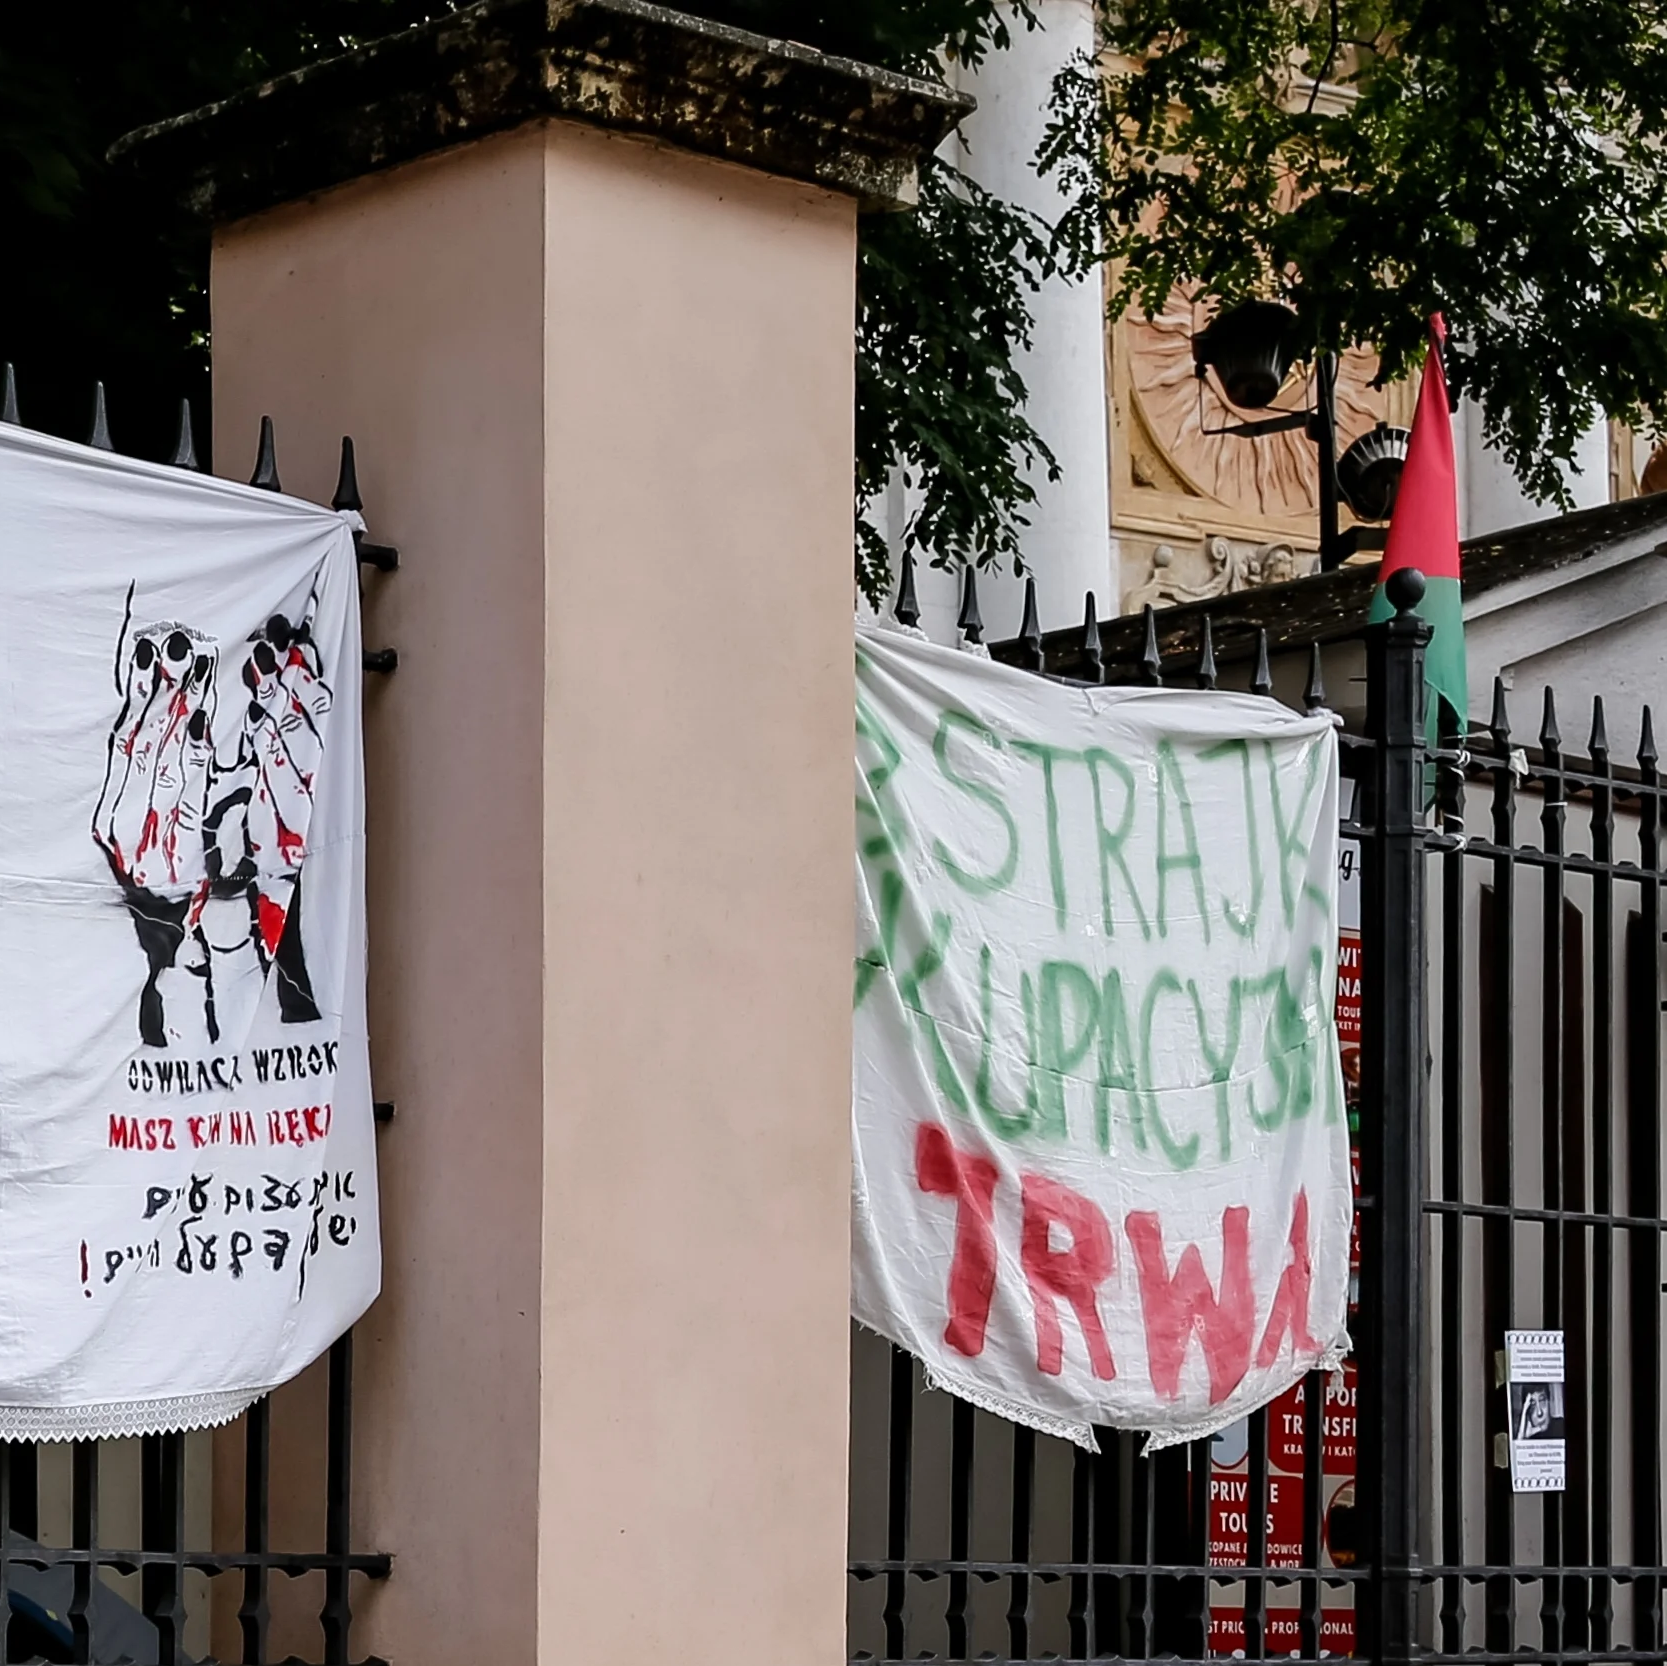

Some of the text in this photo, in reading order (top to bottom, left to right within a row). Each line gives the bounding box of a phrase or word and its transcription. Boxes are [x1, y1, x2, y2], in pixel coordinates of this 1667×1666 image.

[929, 704, 1331, 950] STRAJK
[252, 1041, 339, 1083] WZROK
[108, 1112, 177, 1152] MASZ
[229, 1110, 257, 1146] NA
[915, 1119, 1325, 1406] TRWA
[1210, 1480, 1279, 1503] PRIVE
